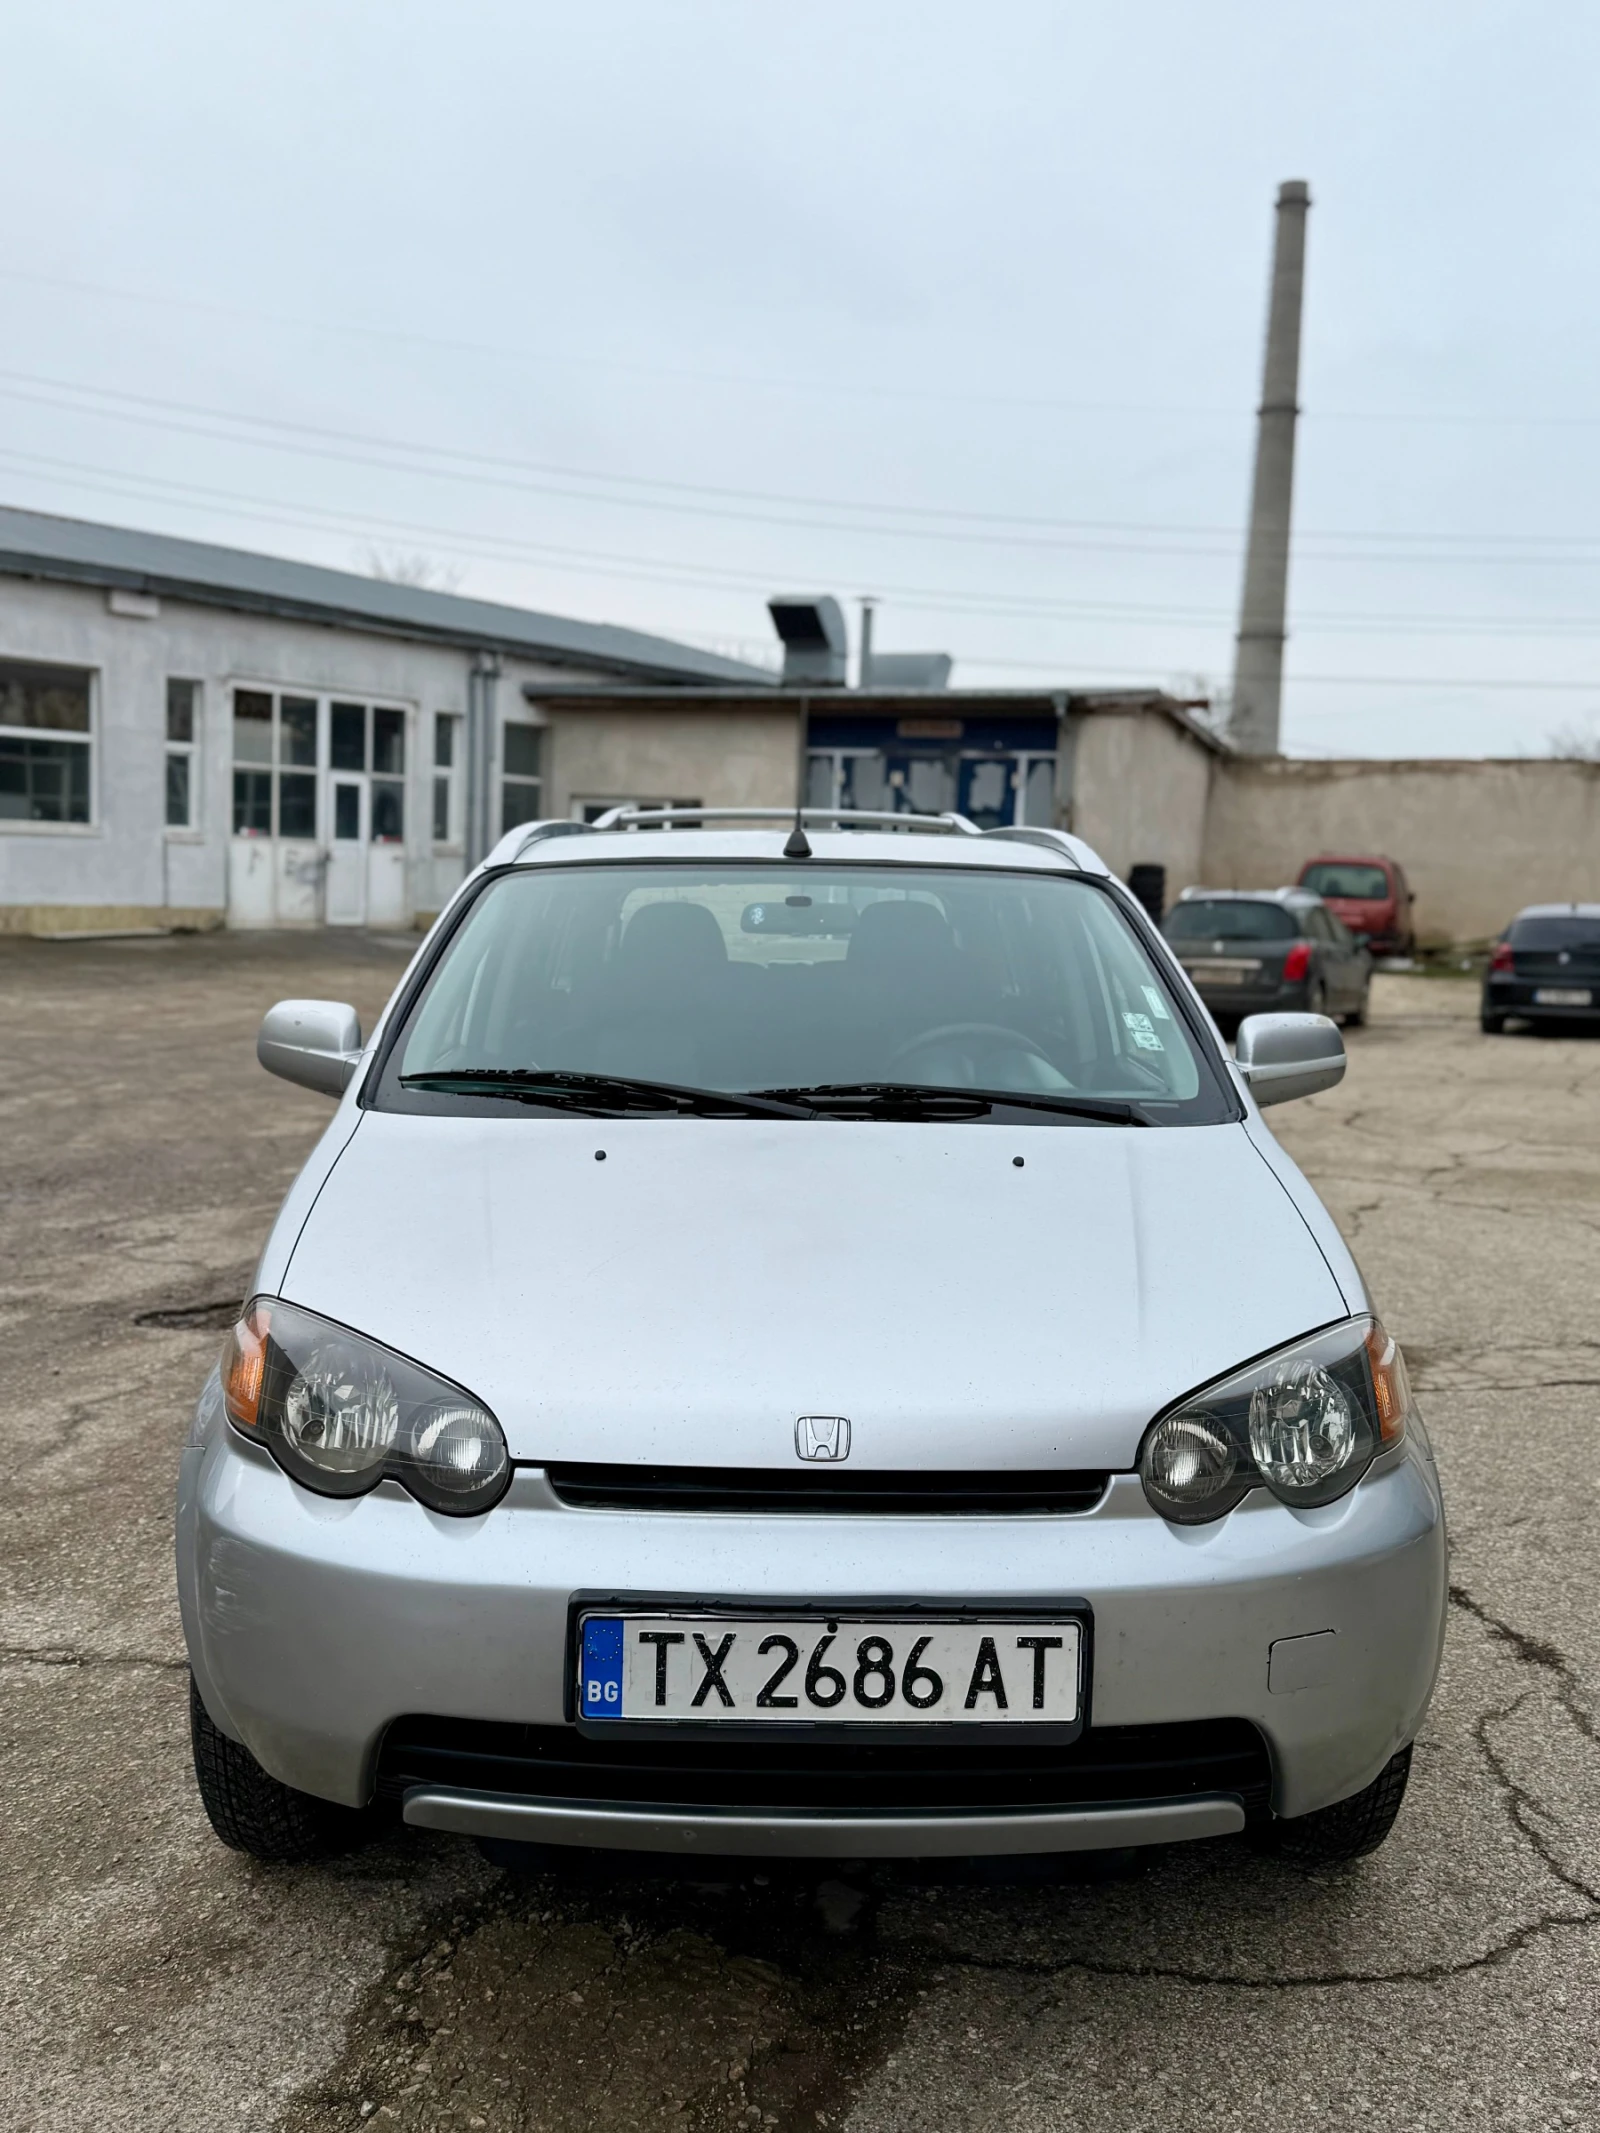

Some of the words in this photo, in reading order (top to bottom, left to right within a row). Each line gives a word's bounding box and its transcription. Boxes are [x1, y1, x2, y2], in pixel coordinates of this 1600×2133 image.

[587, 1681, 619, 1703] BG
[638, 1631, 737, 1708] TX
[756, 1633, 943, 1709] 2686
[964, 1636, 1063, 1710] AT
